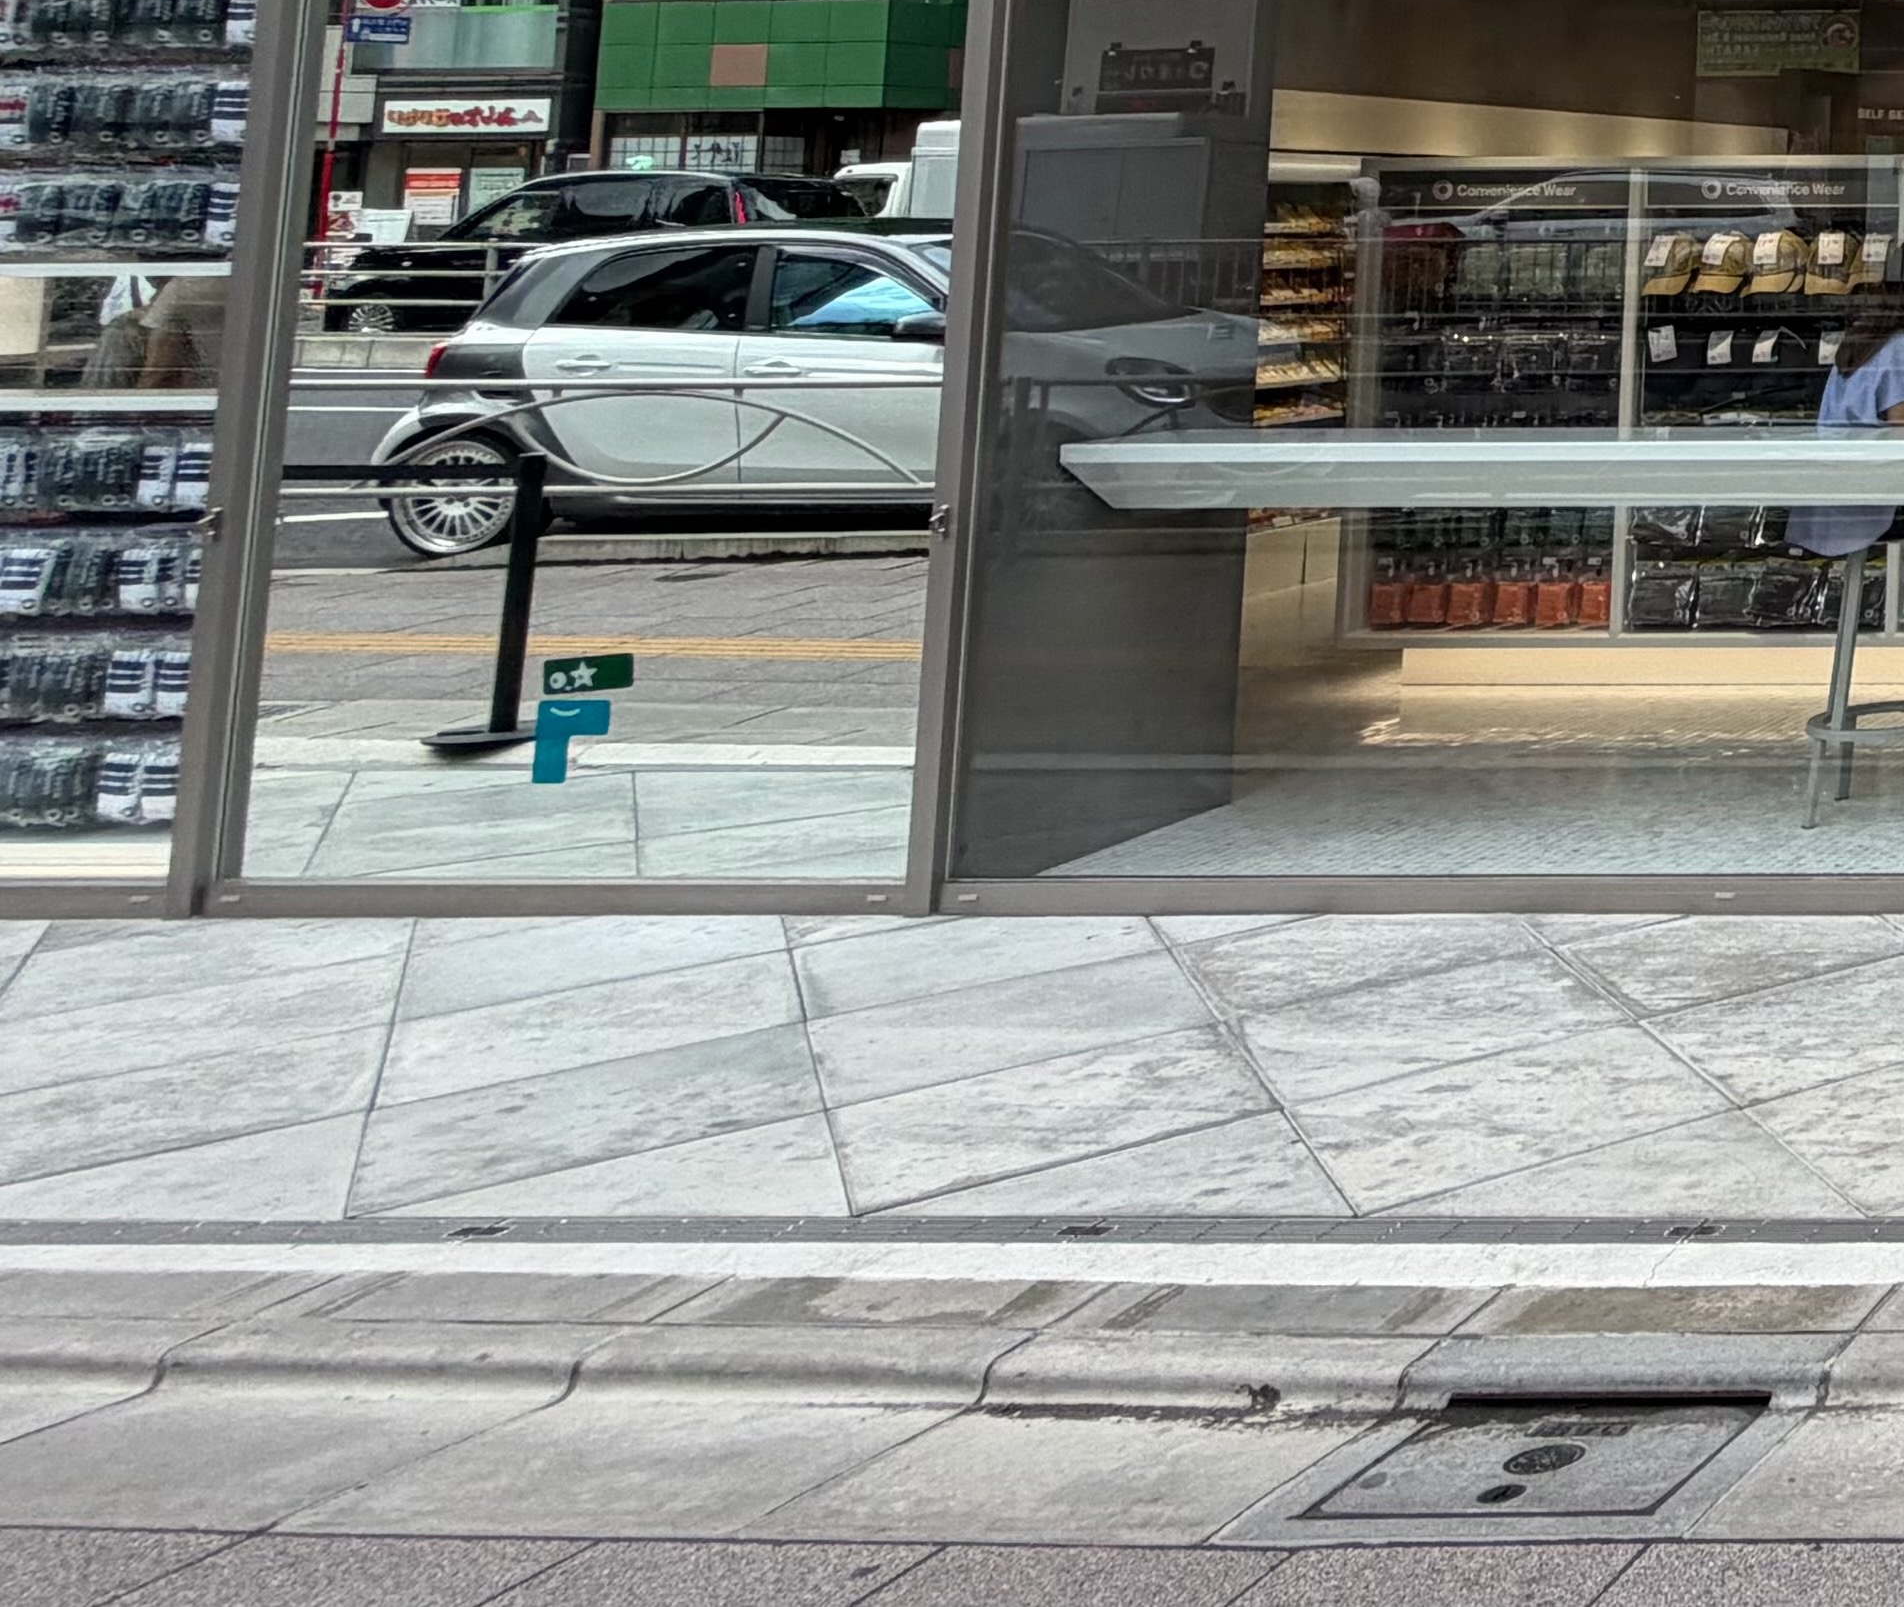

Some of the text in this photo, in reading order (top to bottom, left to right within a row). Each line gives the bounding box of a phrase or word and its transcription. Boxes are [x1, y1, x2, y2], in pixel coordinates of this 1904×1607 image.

[1857, 107, 1885, 120] SELF
[1543, 182, 1577, 198] Wear
[1811, 182, 1846, 197] Wear
